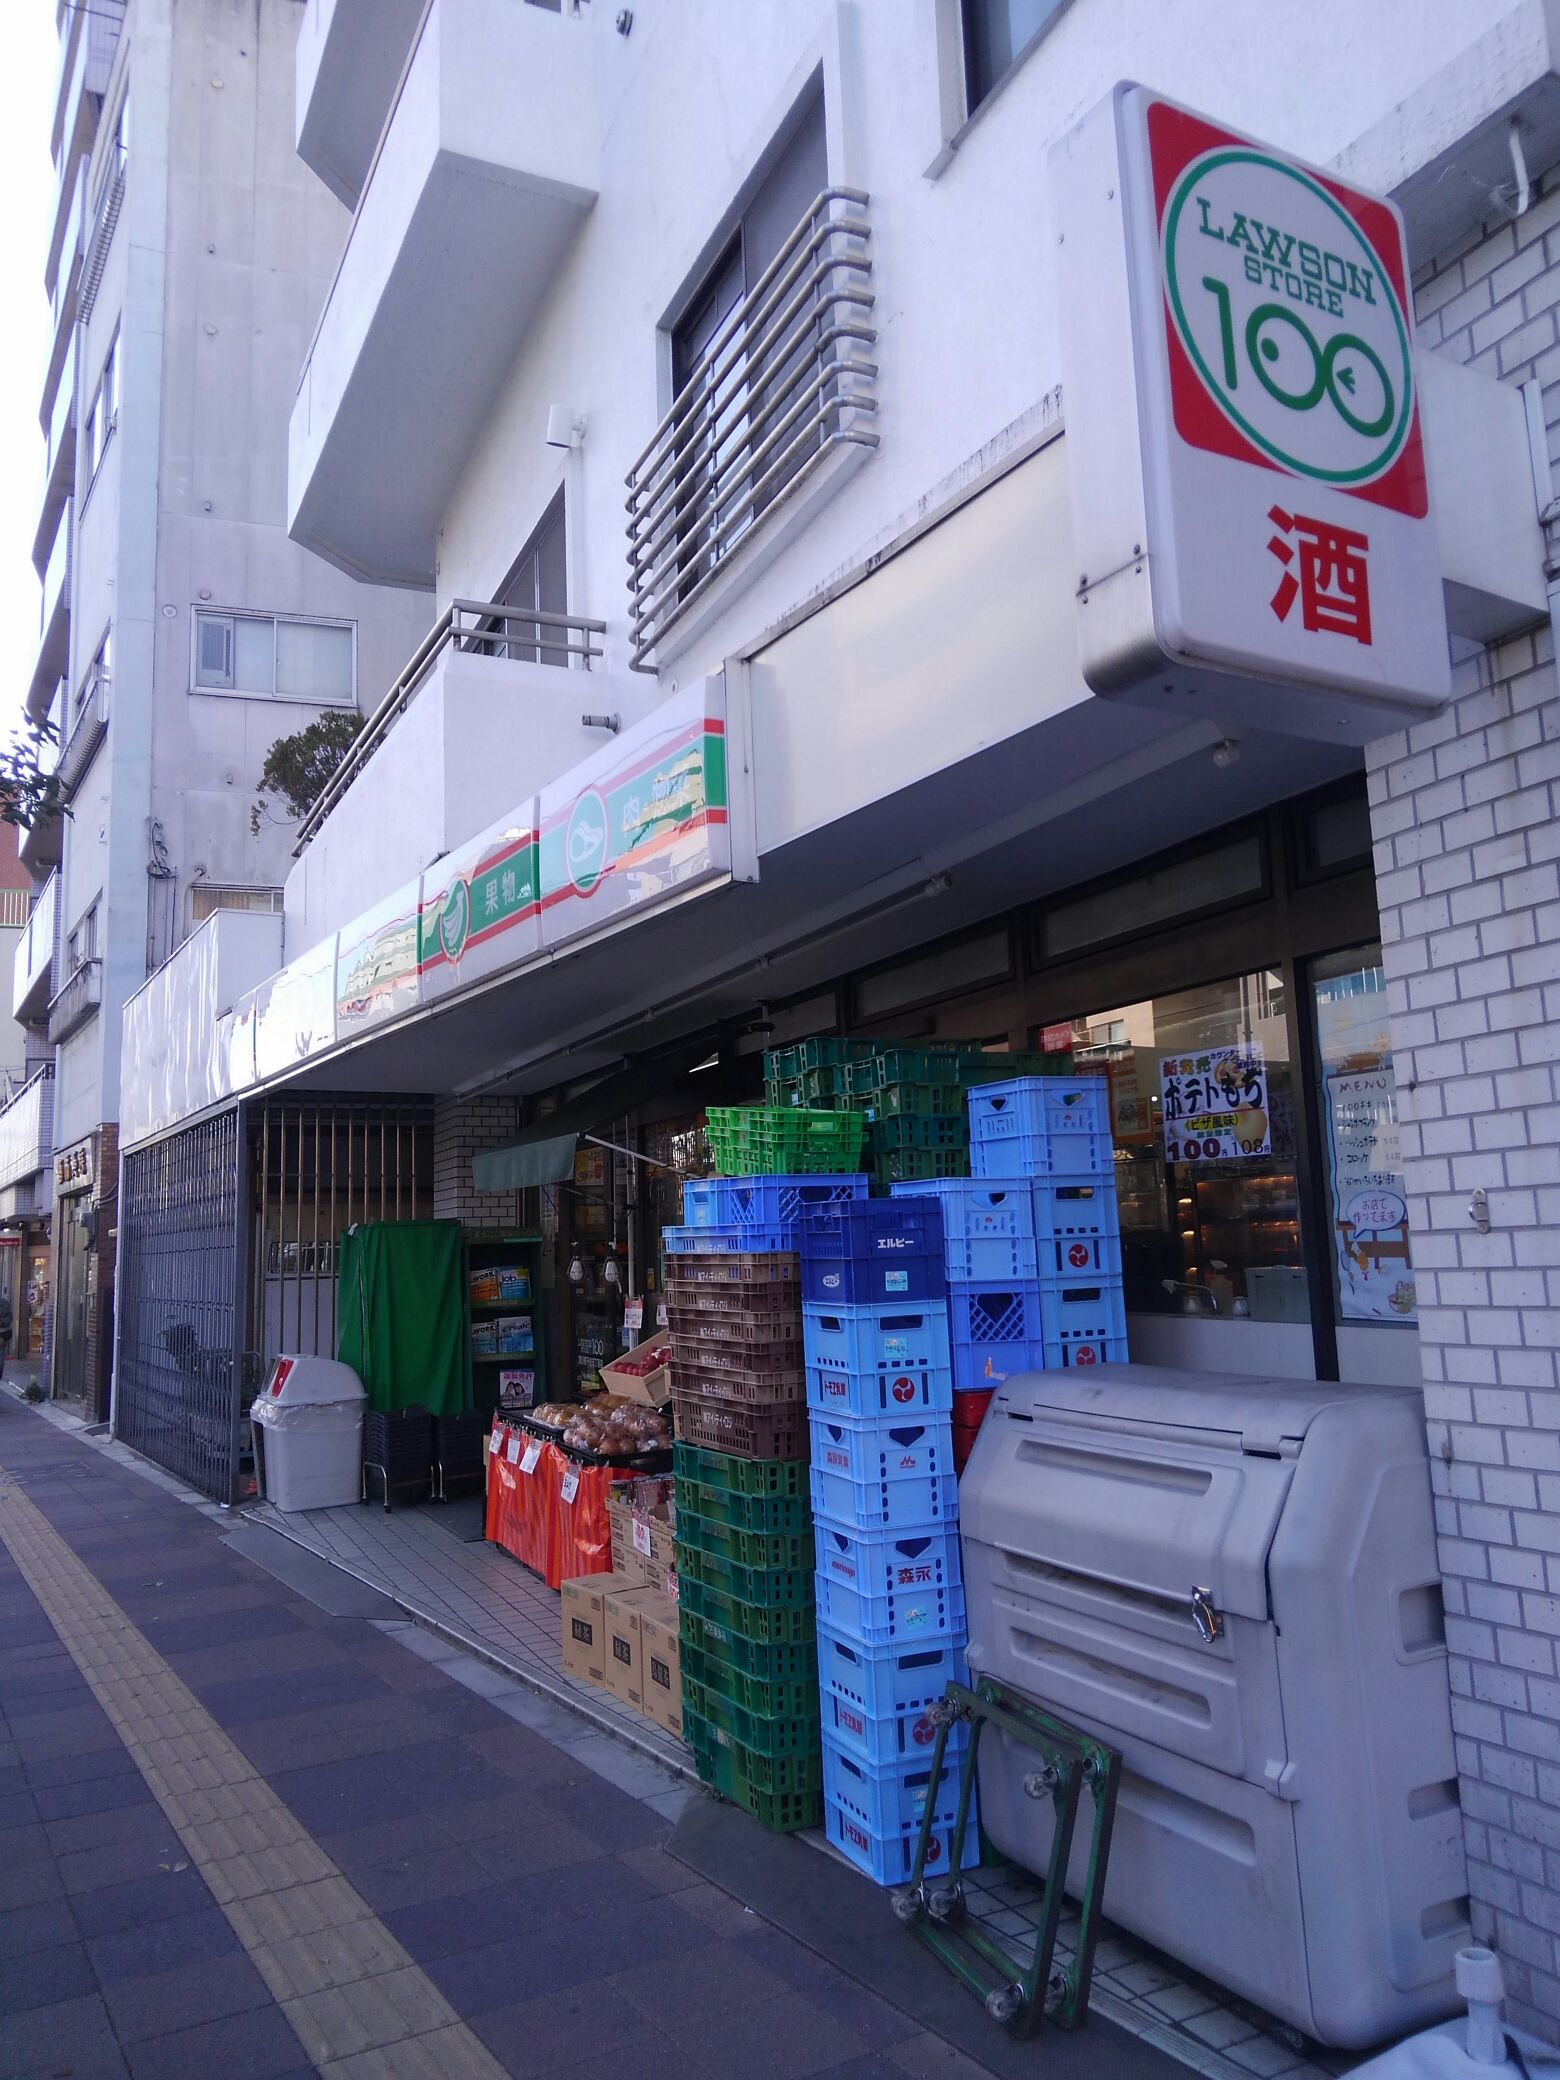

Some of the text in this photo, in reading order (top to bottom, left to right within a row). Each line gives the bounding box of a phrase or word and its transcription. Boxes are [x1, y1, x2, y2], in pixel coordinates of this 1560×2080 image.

[1197, 198, 1377, 306] LAWSON
[1245, 257, 1344, 318] STORE
[1203, 277, 1394, 437] 100
[1267, 505, 1373, 647] 酒
[486, 871, 516, 915] 果物
[1163, 1056, 1211, 1077] 新発売
[1339, 1080, 1386, 1094] MENU
[1164, 1067, 1263, 1121] ポテトもち
[877, 1238, 914, 1249] エルビー
[832, 1560, 856, 1578] morinaga
[898, 1565, 933, 1585] 森永
